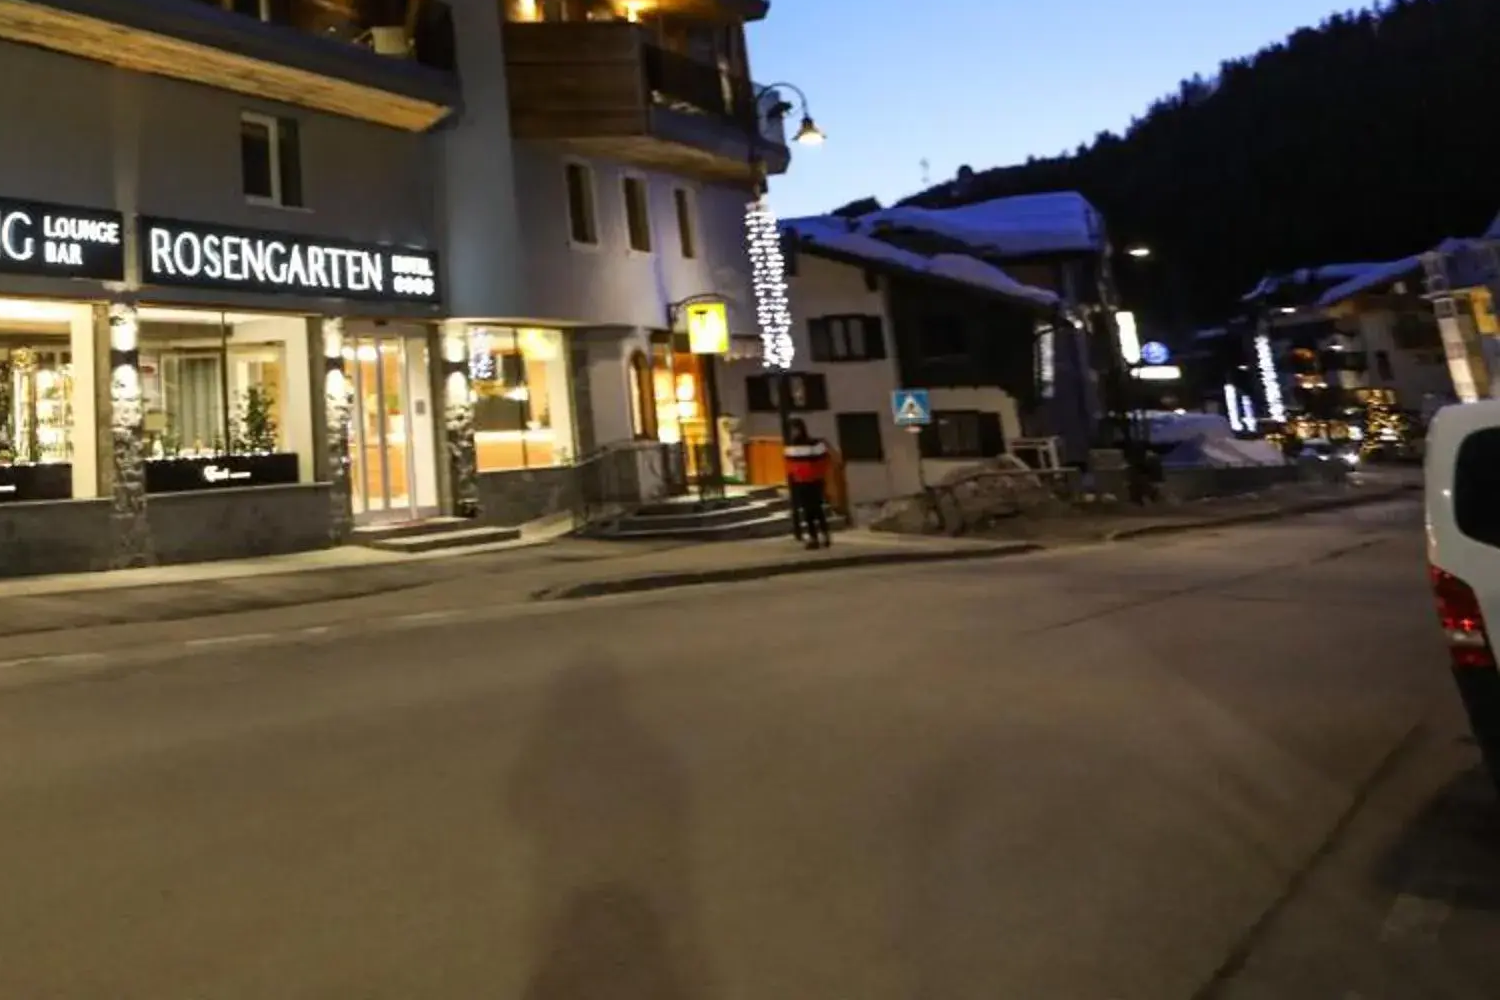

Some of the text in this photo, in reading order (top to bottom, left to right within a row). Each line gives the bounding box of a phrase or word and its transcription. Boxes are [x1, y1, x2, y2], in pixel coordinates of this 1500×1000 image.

[44, 215, 120, 245] LOUNGE
[45, 241, 83, 265] BAR
[150, 228, 383, 291] ROSENGARTEN
